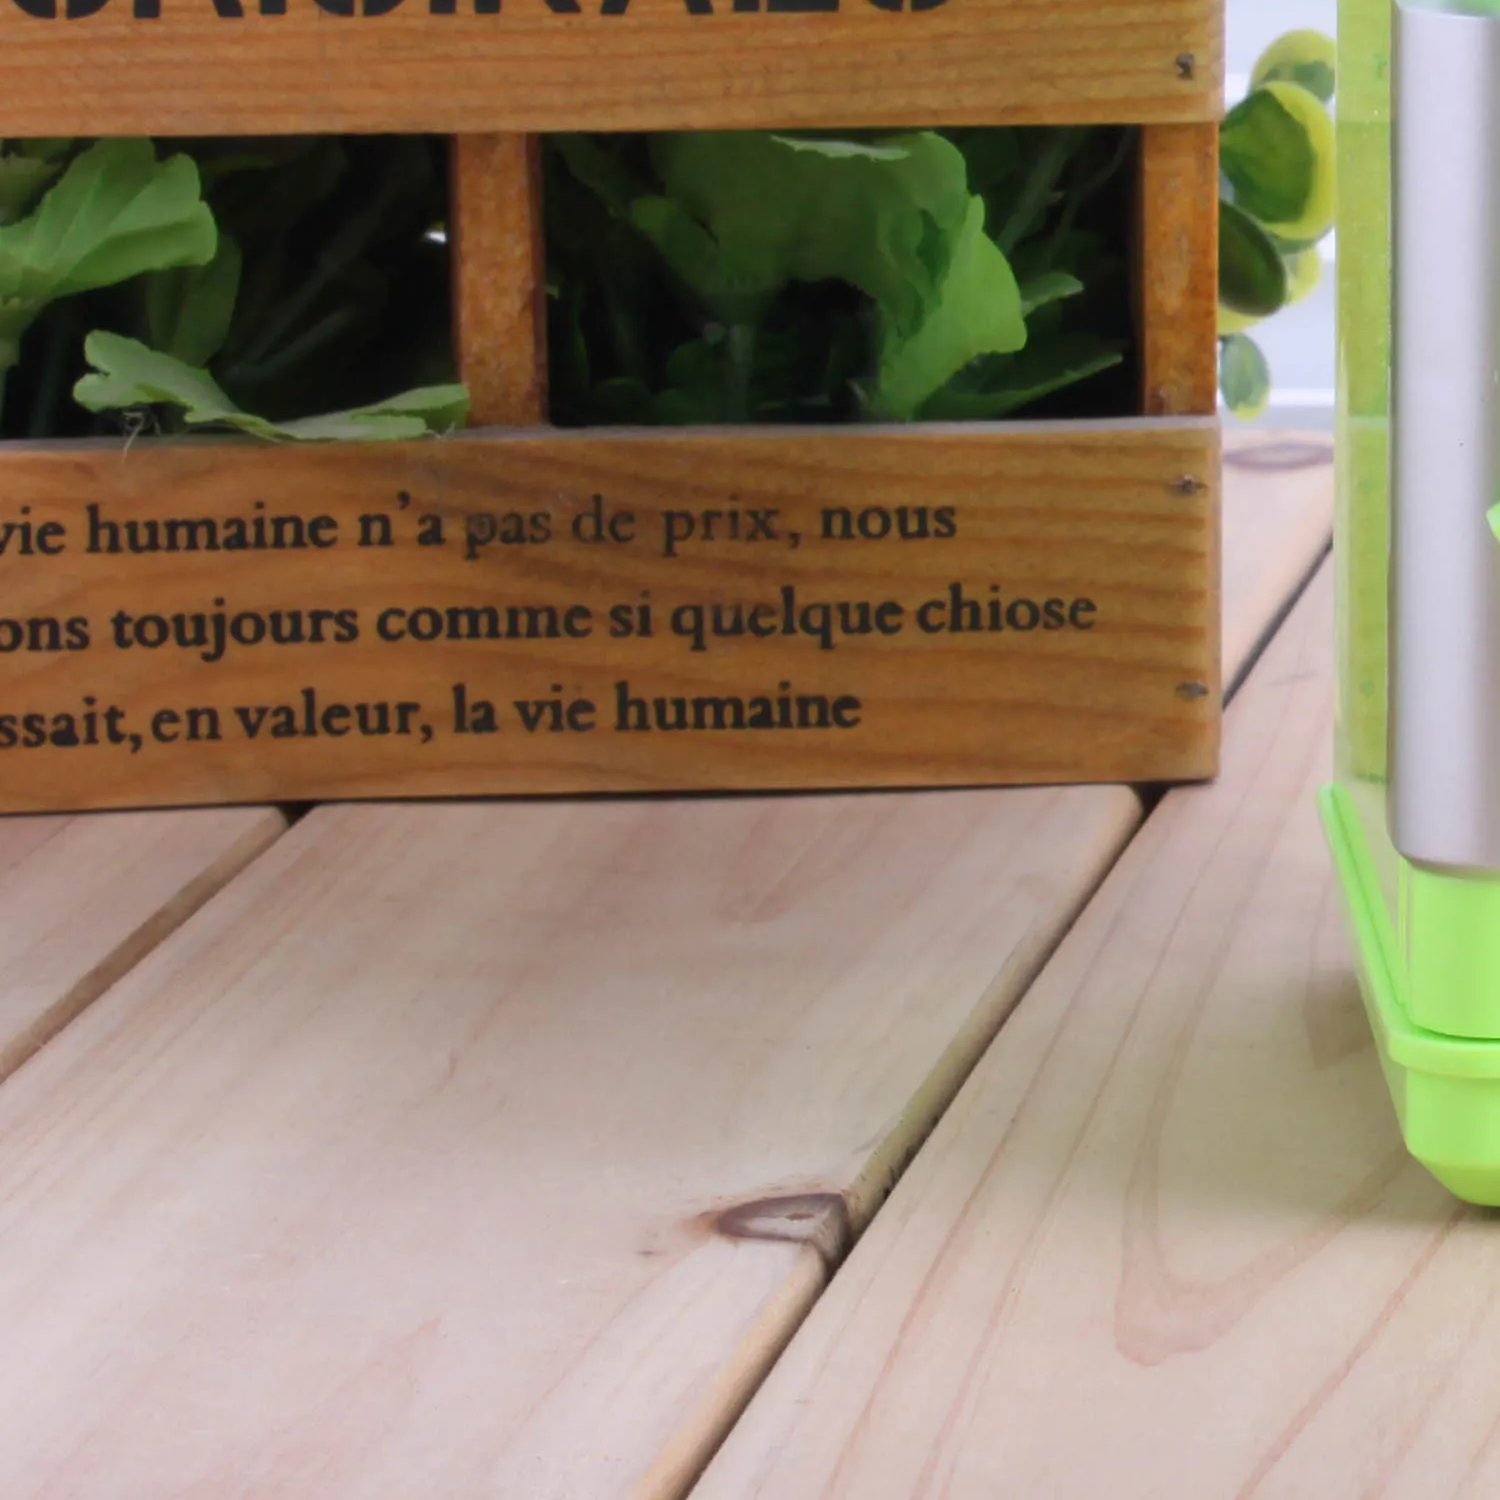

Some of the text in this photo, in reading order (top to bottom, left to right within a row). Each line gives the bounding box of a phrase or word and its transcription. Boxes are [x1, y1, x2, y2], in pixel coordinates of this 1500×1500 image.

[85, 501, 339, 554] humaine
[465, 509, 553, 561] pas
[571, 494, 636, 545] de
[660, 496, 801, 558] prix,
[820, 504, 958, 541] nous
[0, 582, 1098, 663] ons toujours comme si quelque chiose
[233, 687, 434, 744] valeur,
[452, 683, 499, 735] la
[513, 683, 596, 733] vie
[614, 681, 863, 732] humaine
